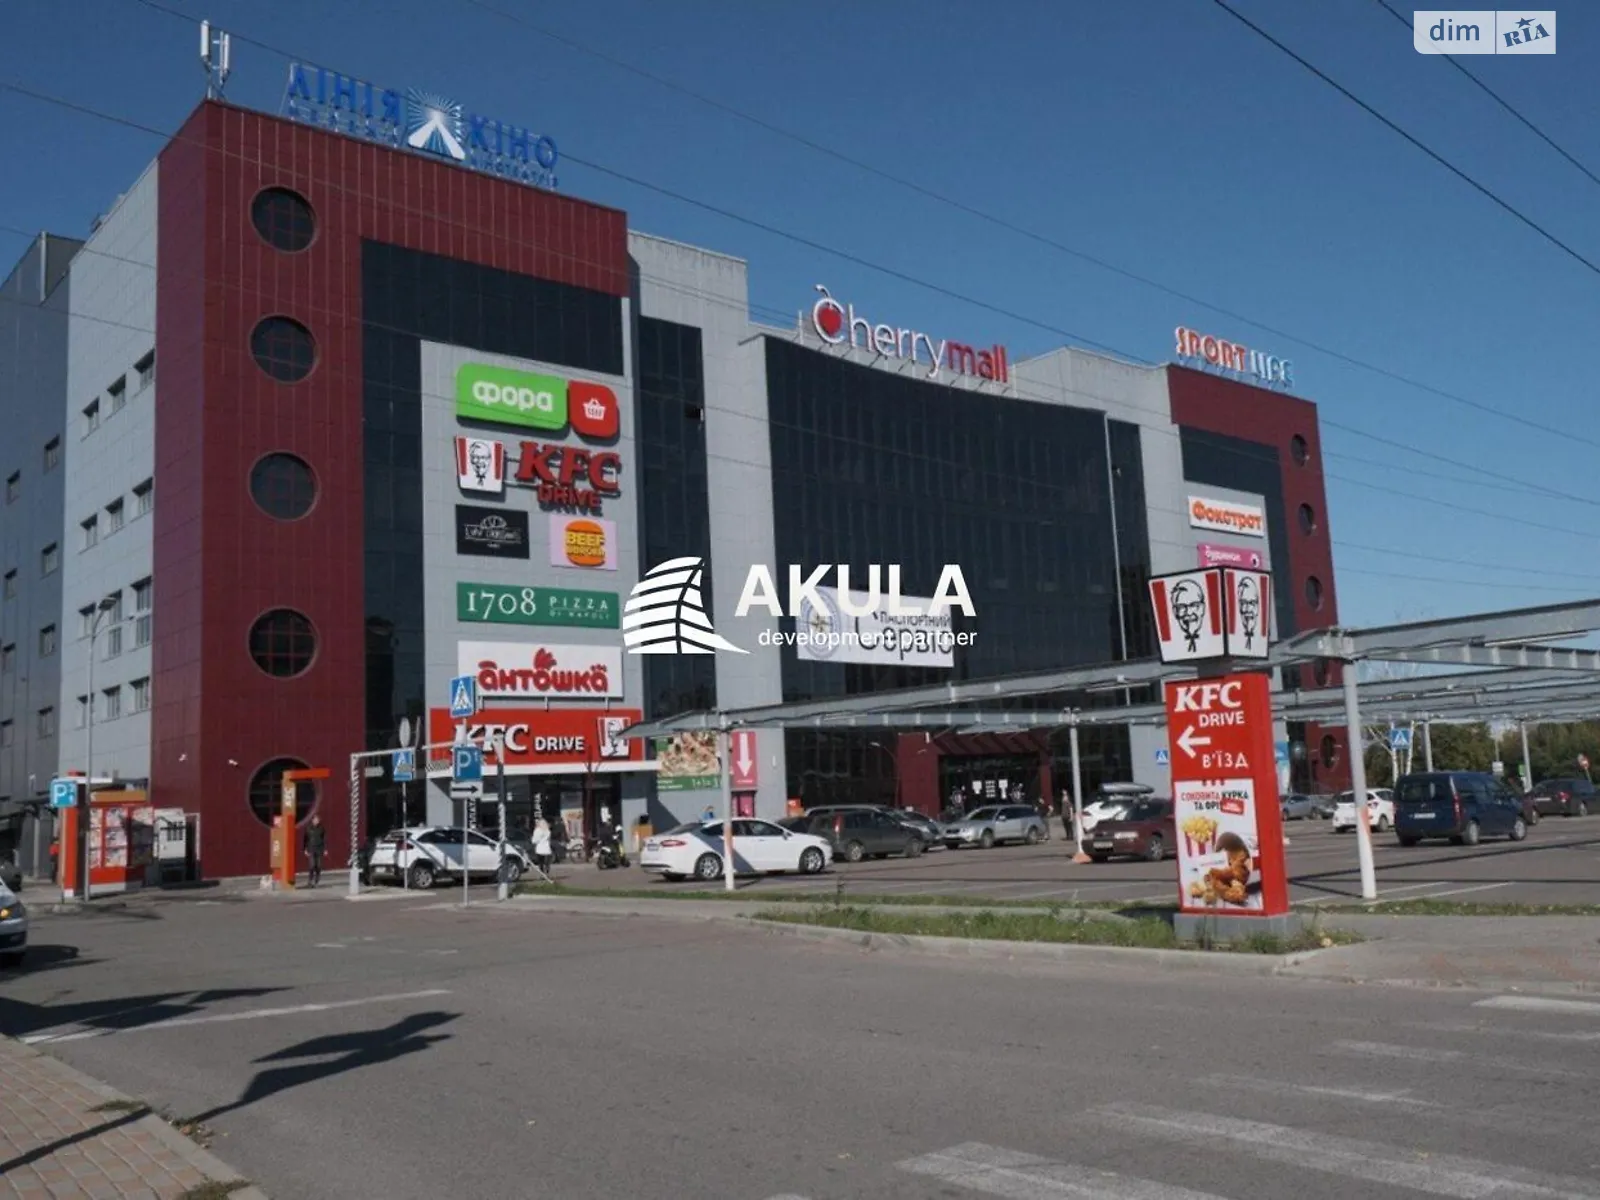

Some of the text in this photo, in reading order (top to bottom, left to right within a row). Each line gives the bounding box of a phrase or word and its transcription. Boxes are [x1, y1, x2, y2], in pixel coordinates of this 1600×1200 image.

[467, 113, 557, 168] КІНО
[1175, 326, 1246, 372] SPORT
[514, 440, 620, 491] KFC
[538, 484, 601, 508] DRIVE
[566, 532, 605, 546] BEEF
[467, 588, 608, 620] 1708 PIZZA
[1174, 682, 1241, 711] KFC
[1199, 711, 1245, 727] DRIVE
[455, 723, 586, 752] KFC DRIVE
